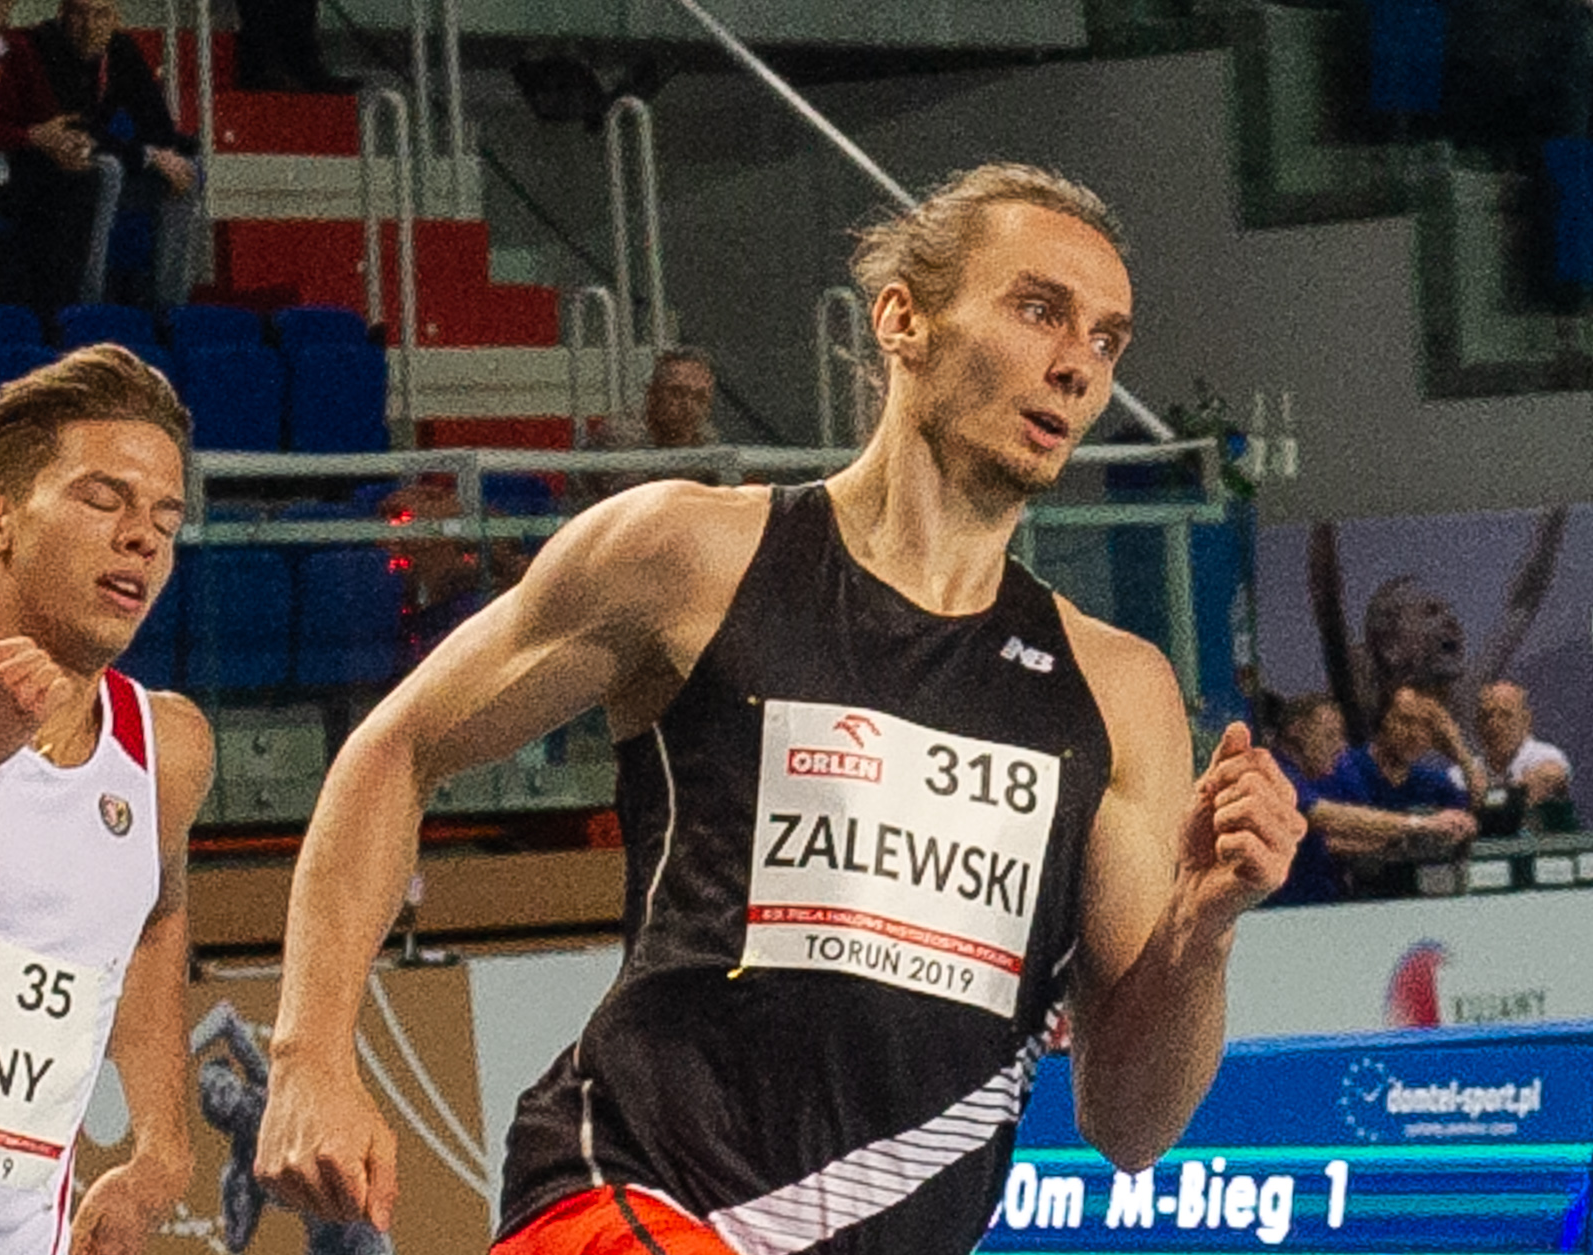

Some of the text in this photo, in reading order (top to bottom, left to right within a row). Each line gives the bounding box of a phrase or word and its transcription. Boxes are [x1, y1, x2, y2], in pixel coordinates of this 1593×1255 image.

[790, 751, 881, 783] ORLEN
[924, 743, 1039, 815] 318
[763, 813, 1031, 918] ZALEWSKI
[16, 962, 77, 1020] 35
[805, 933, 902, 976] TORUŃ
[907, 955, 976, 994] 2019
[989, 1156, 1349, 1244] 0m M-Bieg 1
